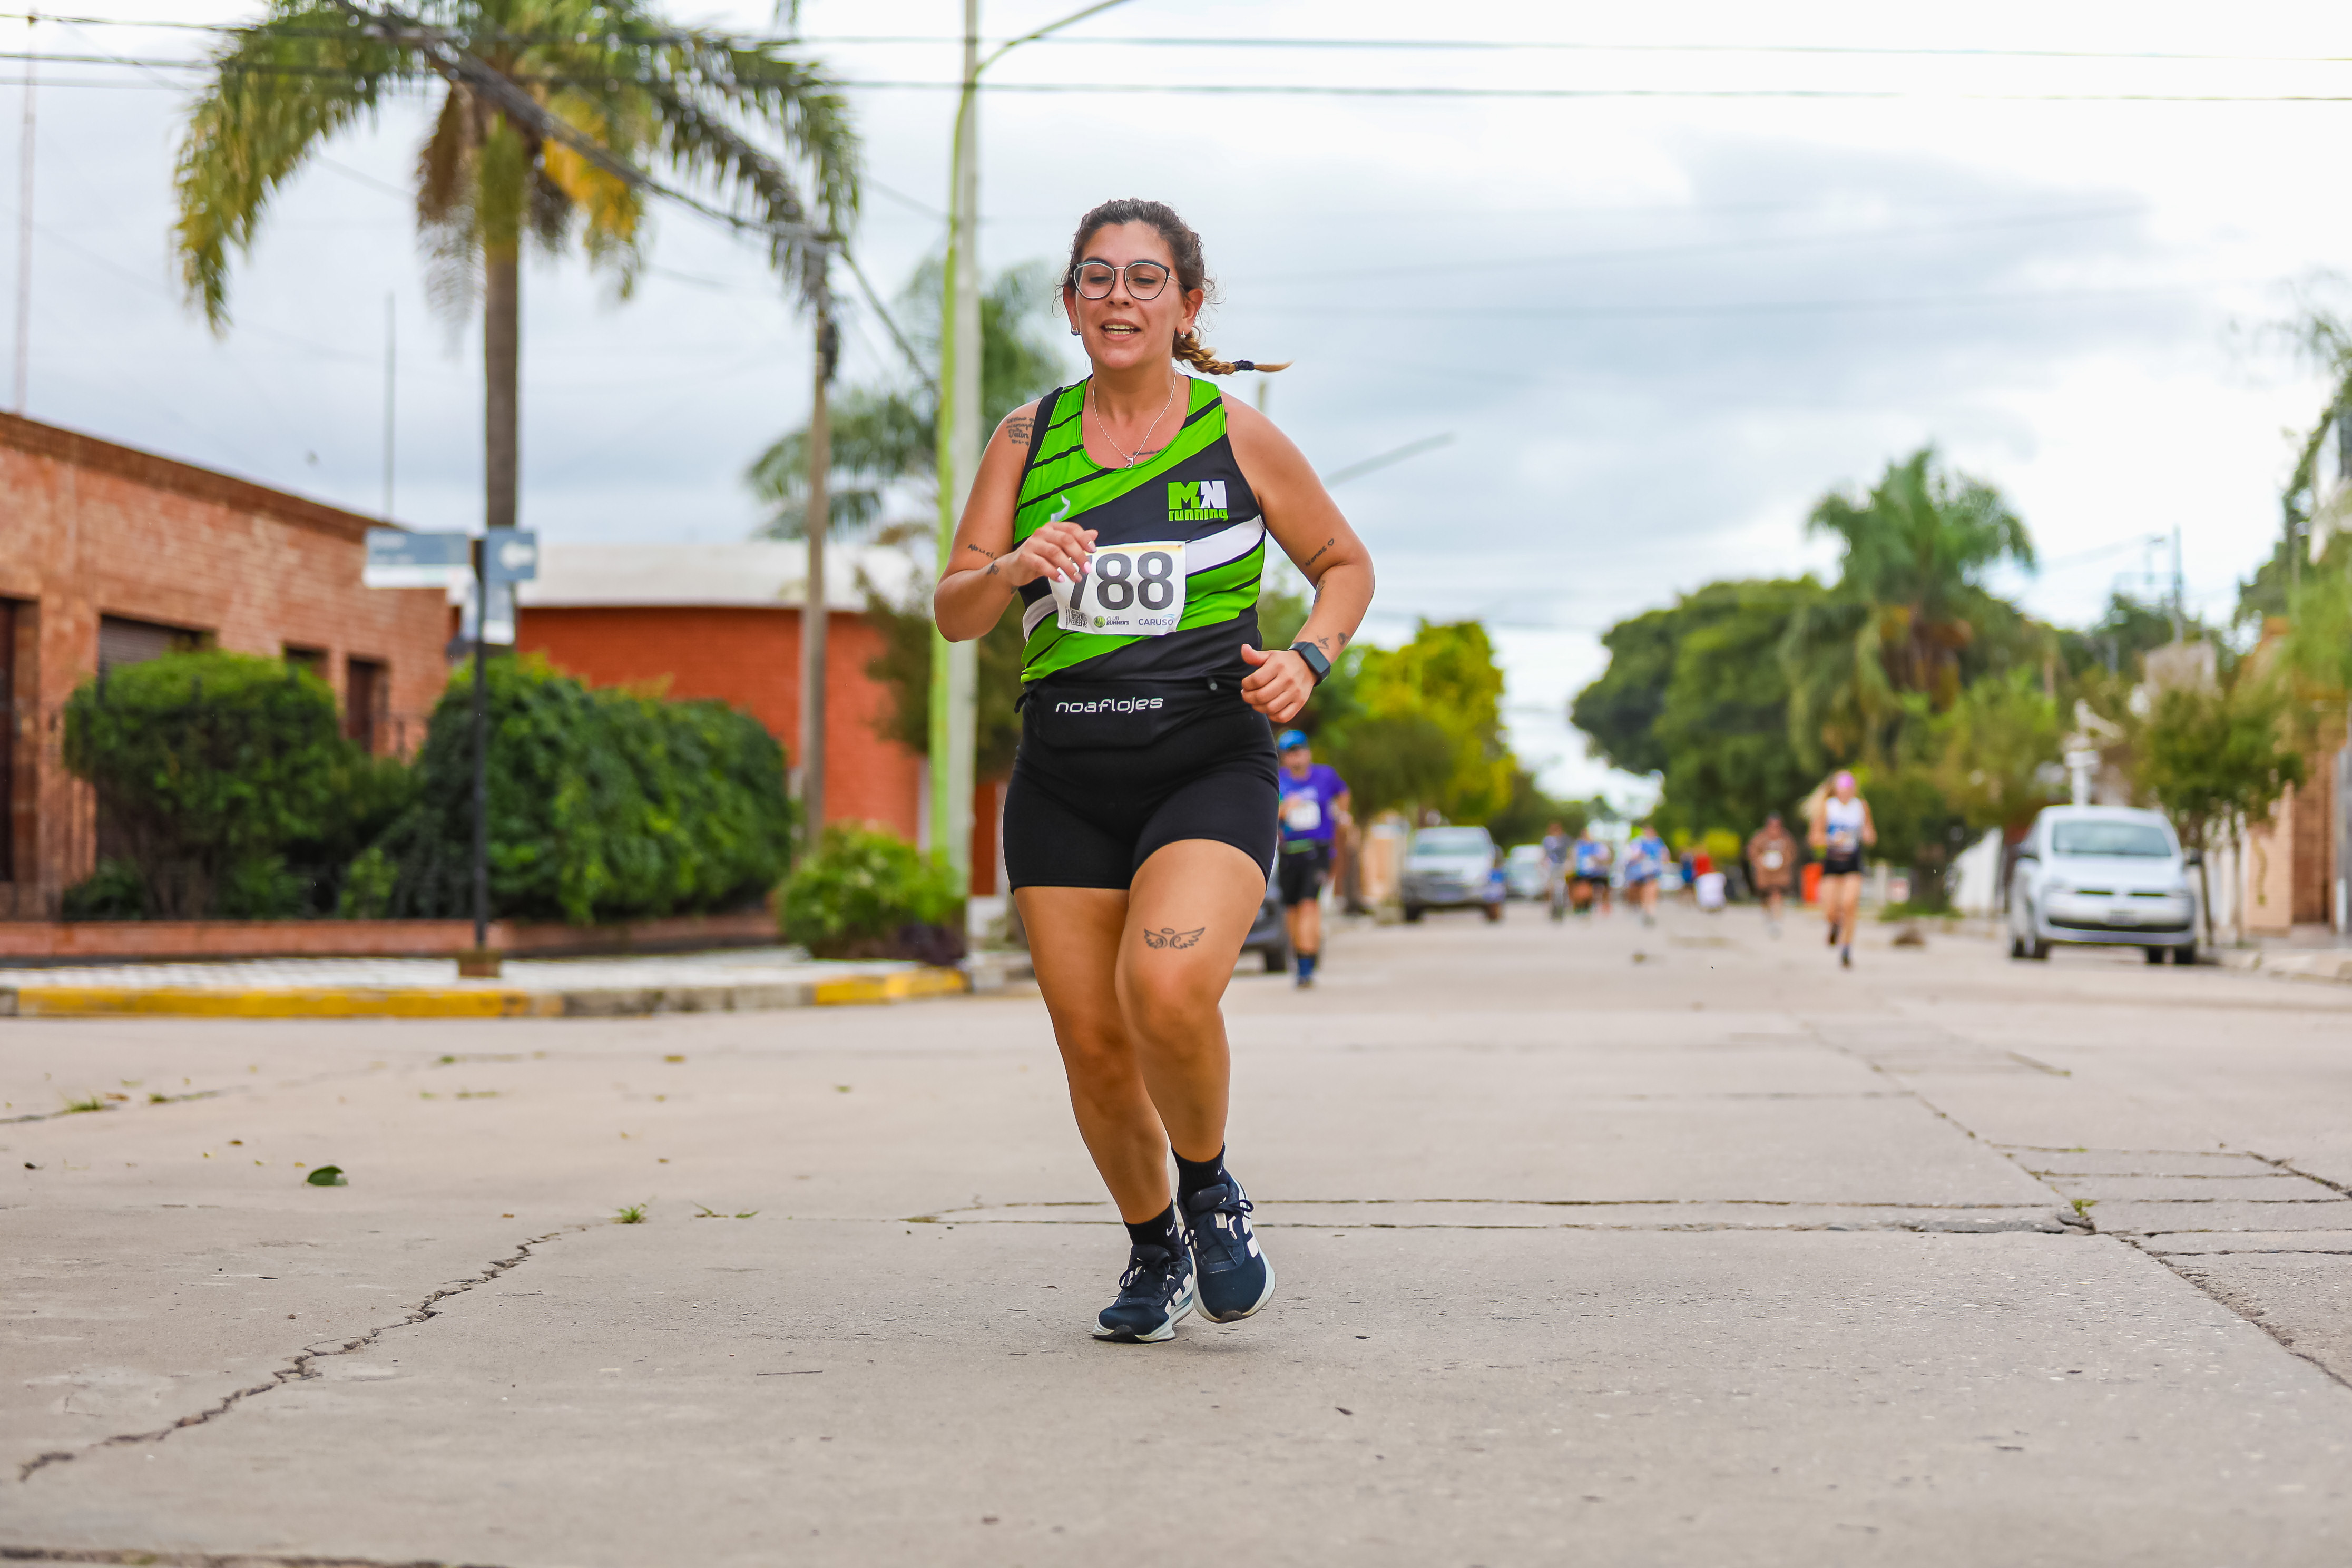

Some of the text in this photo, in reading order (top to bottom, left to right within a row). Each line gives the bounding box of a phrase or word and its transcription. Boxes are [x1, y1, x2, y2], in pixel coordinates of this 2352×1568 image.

[1168, 480, 1227, 510] MN
[1169, 509, 1228, 521] running
[1055, 697, 1163, 714] noaflojes
